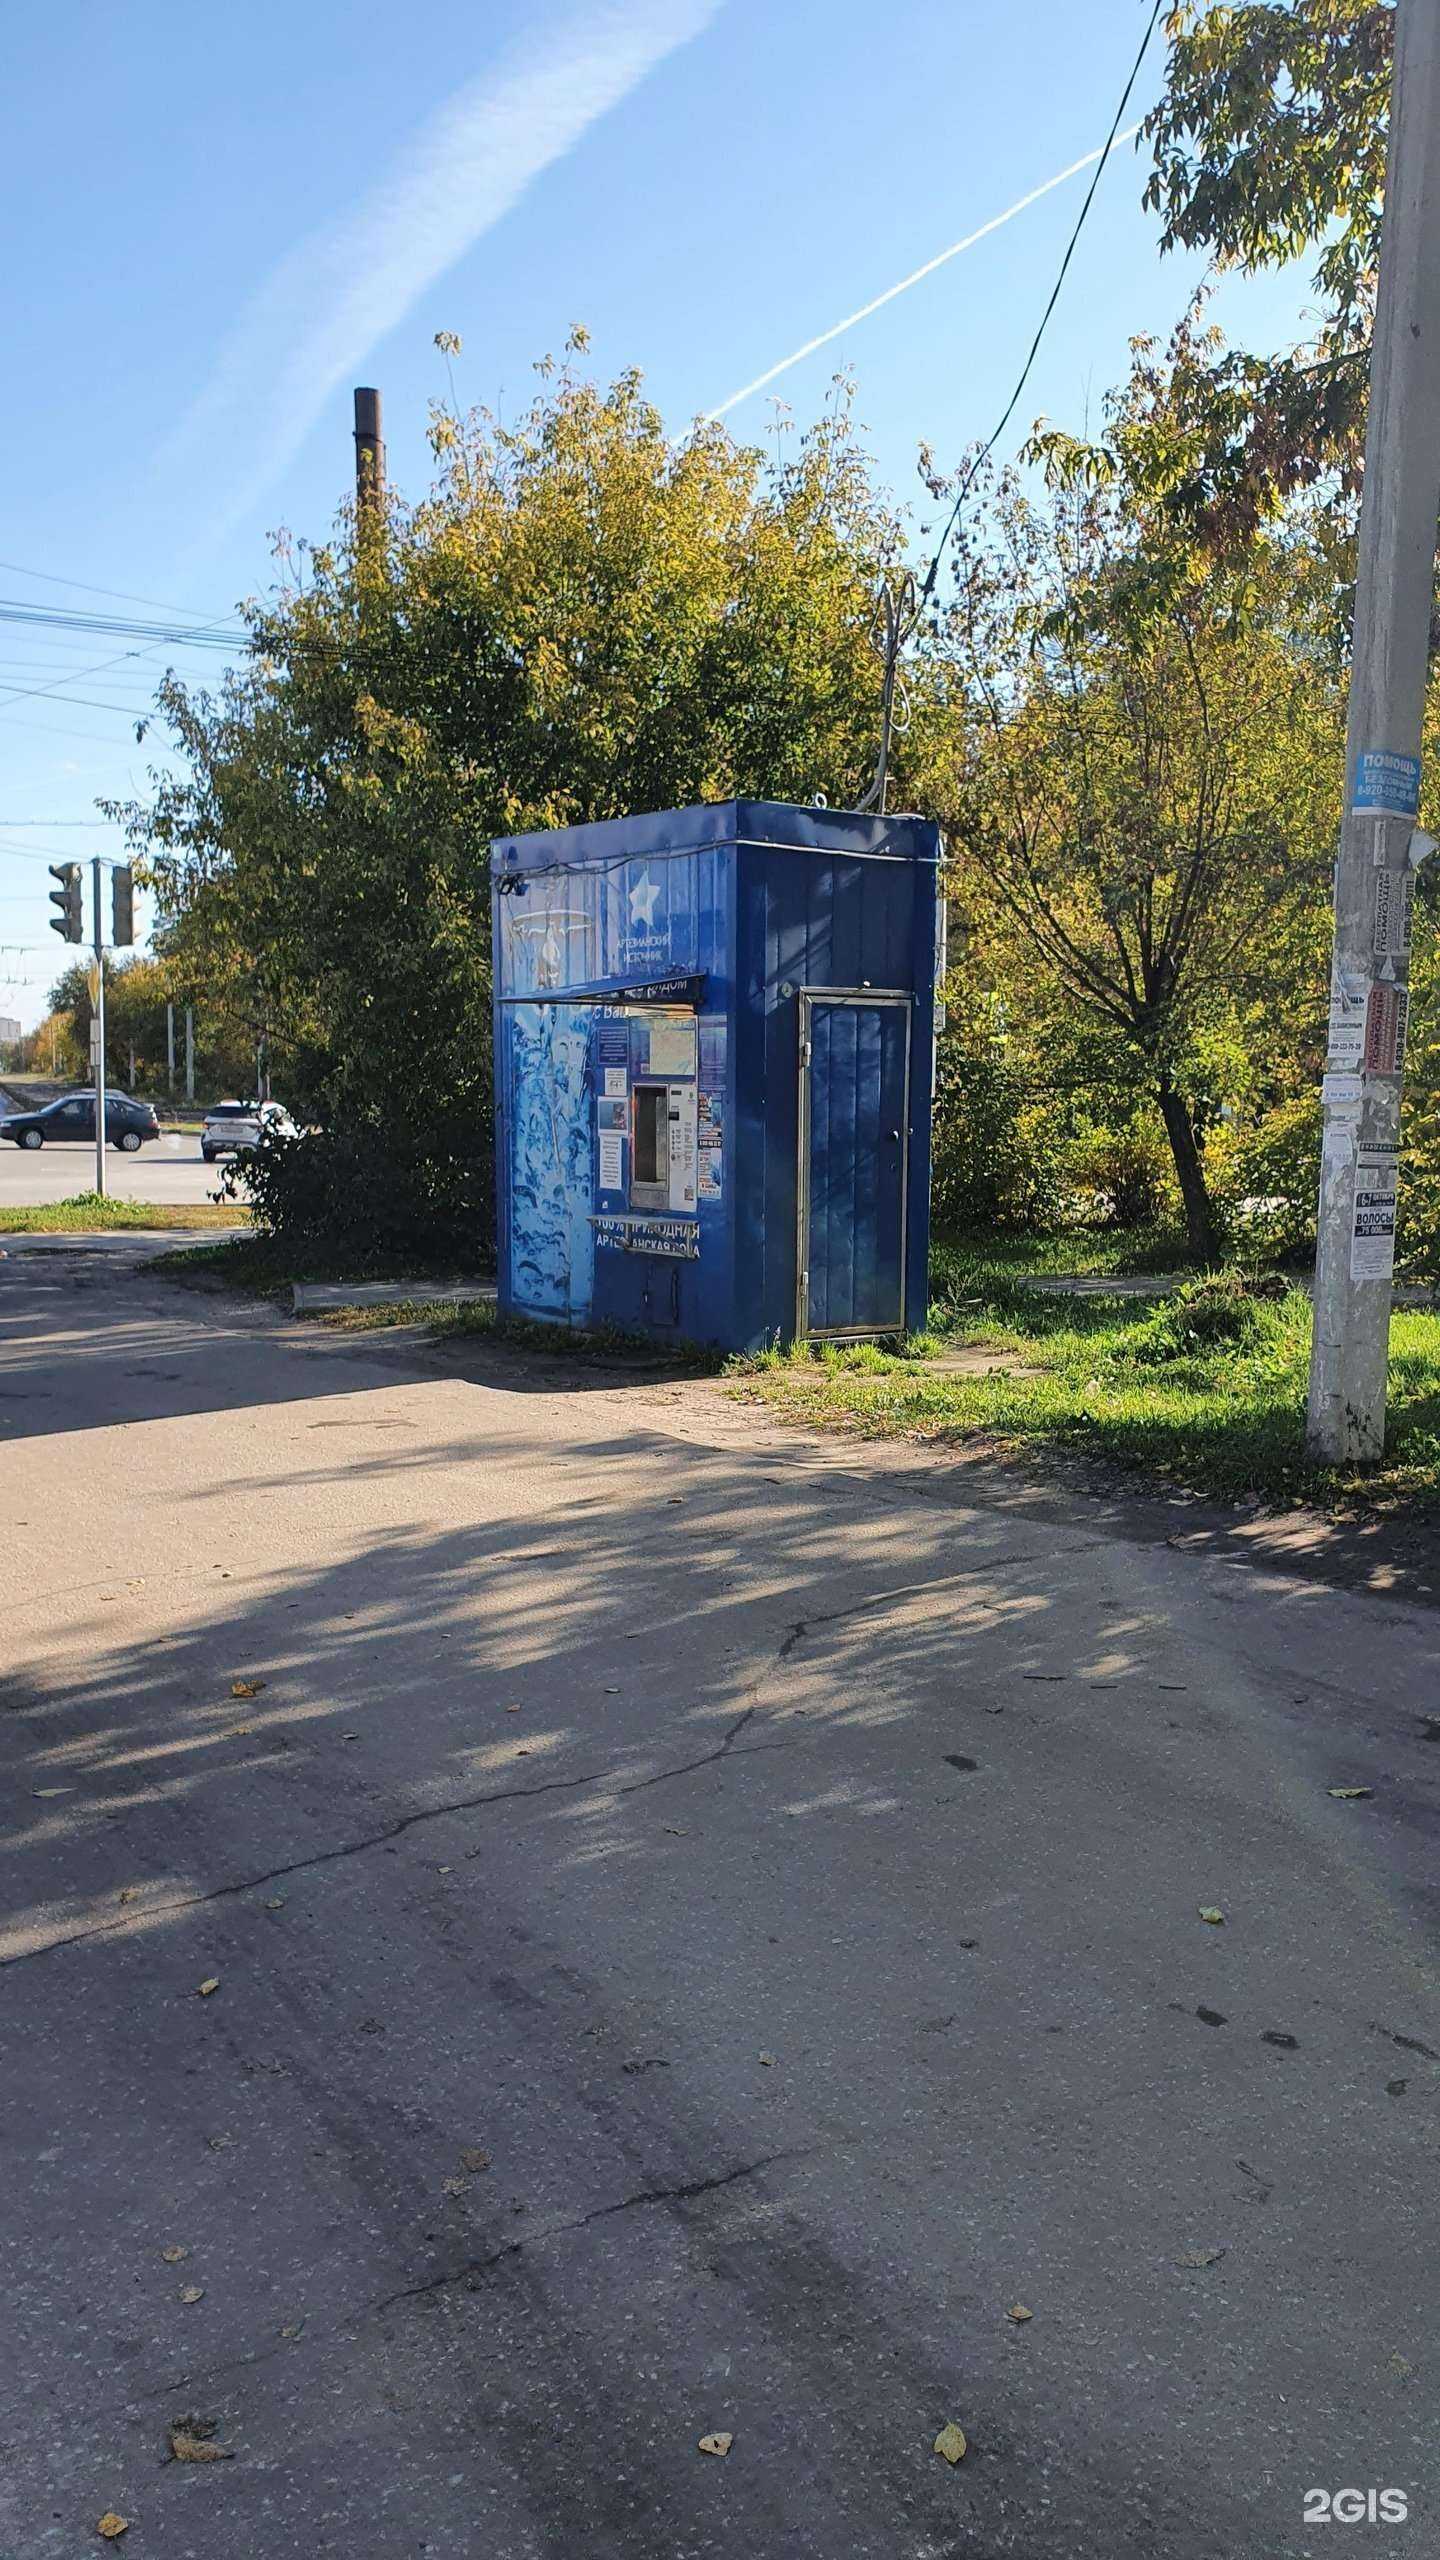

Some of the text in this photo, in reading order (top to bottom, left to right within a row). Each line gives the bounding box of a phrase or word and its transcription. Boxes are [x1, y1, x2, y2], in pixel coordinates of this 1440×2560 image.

[1363, 754, 1416, 775] ПОМОЩЬ
[1380, 873, 1390, 952] ПОМОЩЬ
[1331, 996, 1365, 1004] ПОЩЬ
[1357, 1212, 1394, 1224] ВОЛОСЫ
